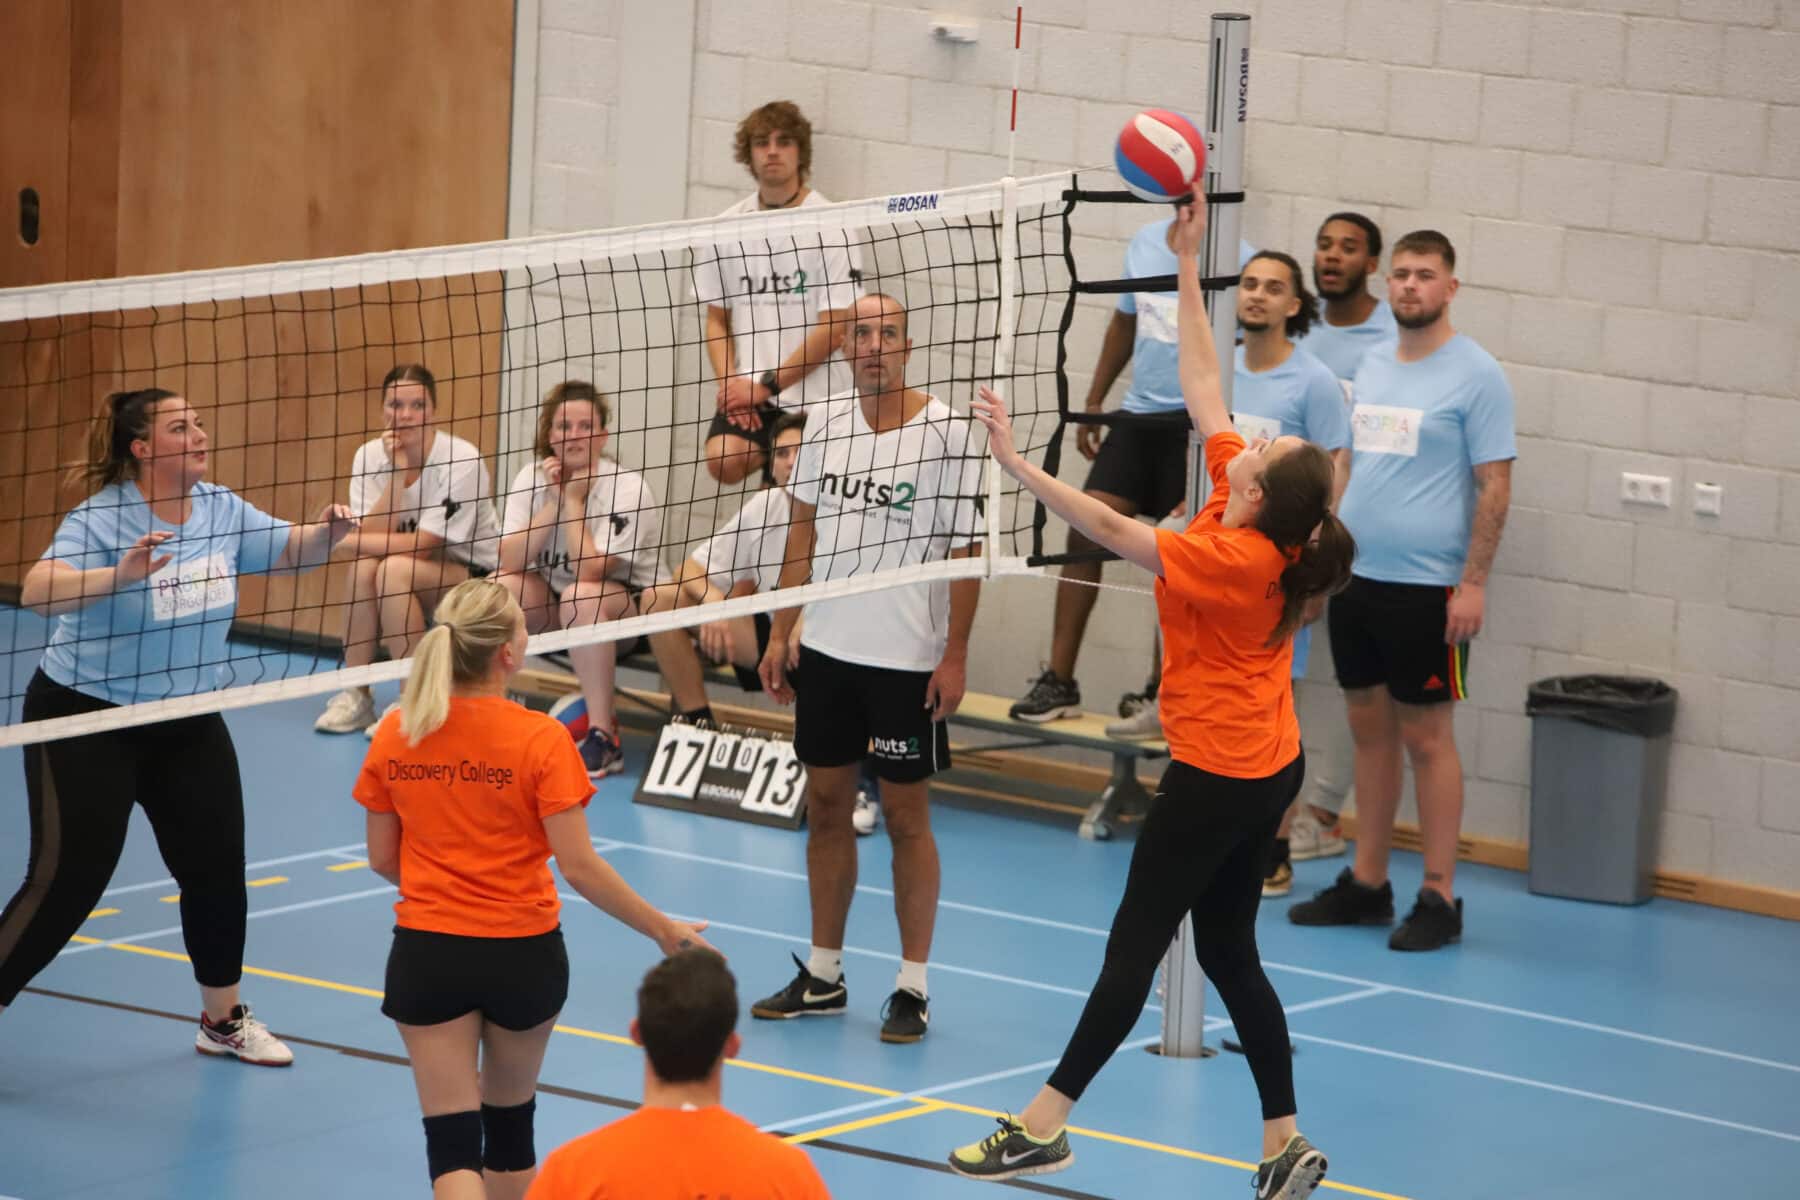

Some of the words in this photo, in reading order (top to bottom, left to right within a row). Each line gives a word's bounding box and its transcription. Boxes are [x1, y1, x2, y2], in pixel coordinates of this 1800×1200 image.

[1239, 63, 1249, 122] BOSAN
[897, 194, 939, 213] BOSAN
[740, 269, 808, 294] nuts2
[820, 472, 916, 513] nuts2
[874, 737, 920, 753] nuts2
[388, 760, 457, 787] Discovery
[459, 760, 513, 790] College
[657, 739, 705, 787] 17
[756, 757, 804, 806] 13
